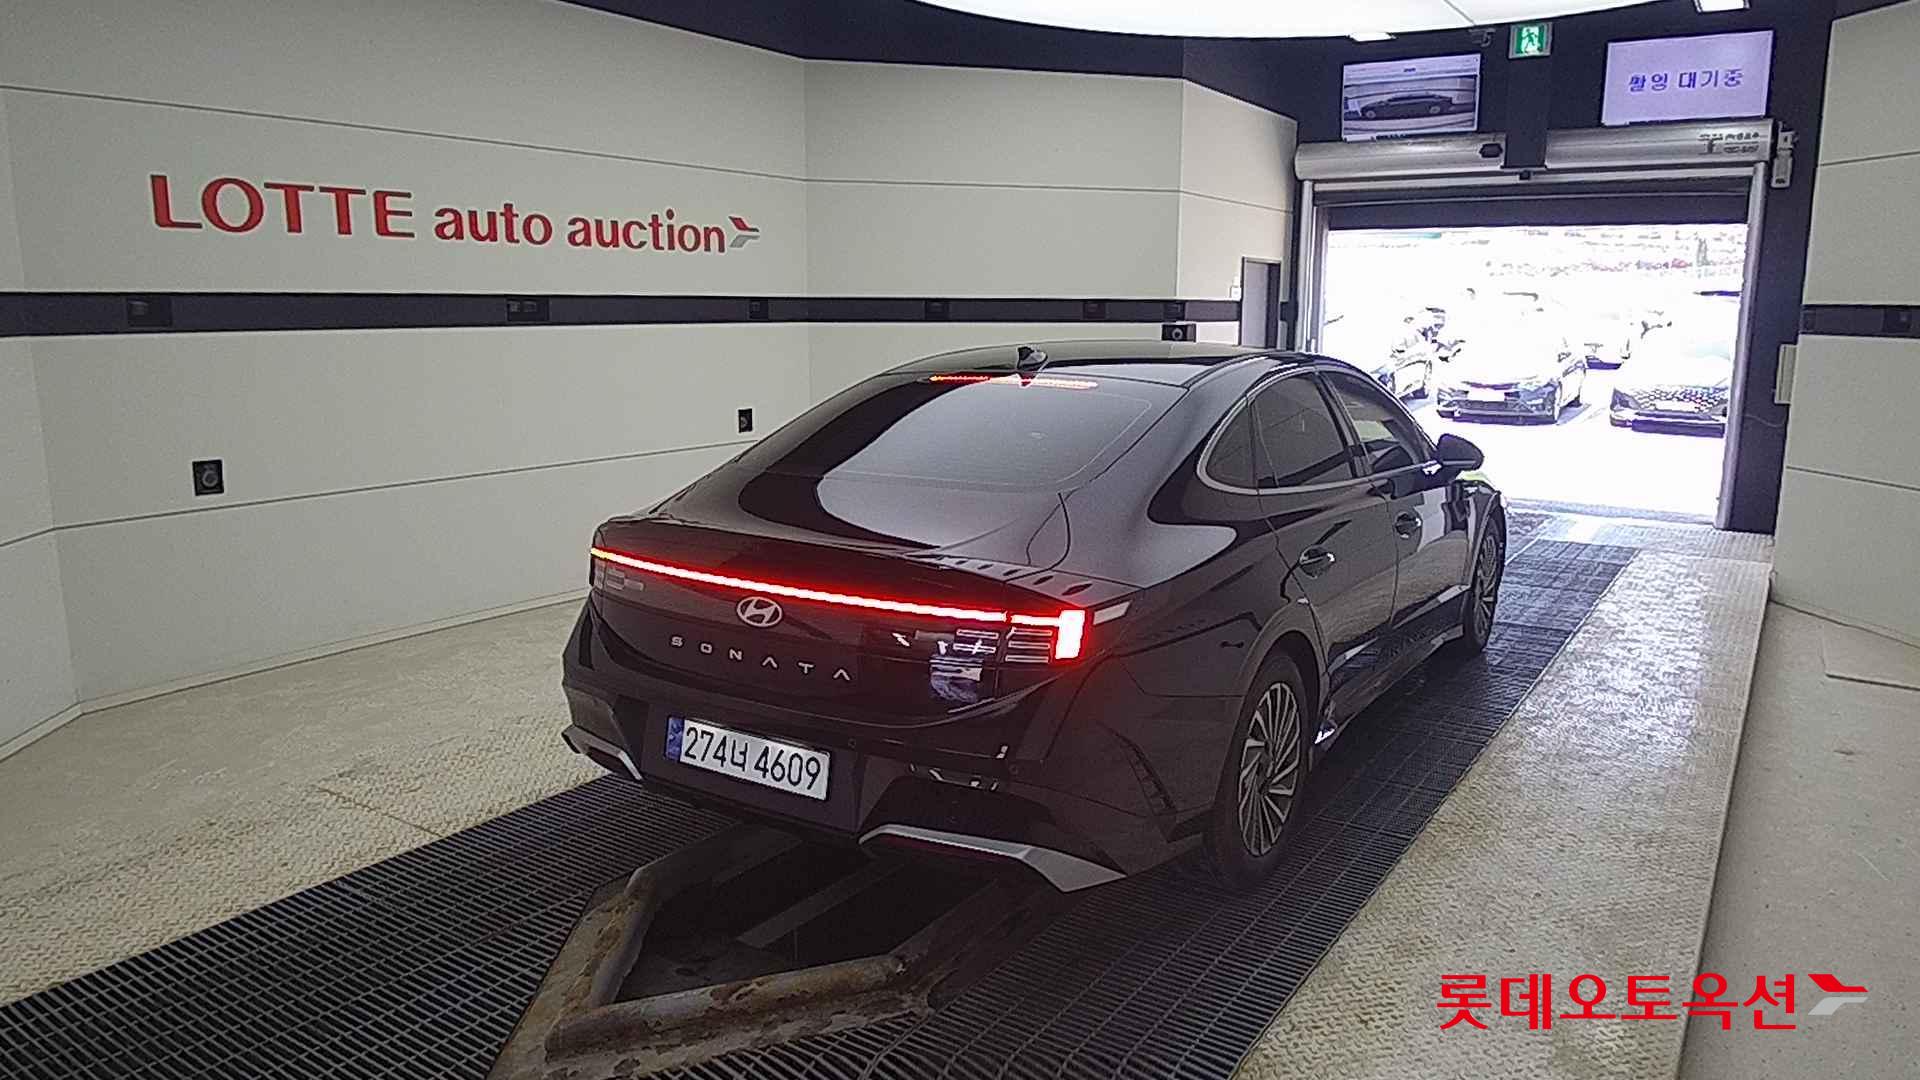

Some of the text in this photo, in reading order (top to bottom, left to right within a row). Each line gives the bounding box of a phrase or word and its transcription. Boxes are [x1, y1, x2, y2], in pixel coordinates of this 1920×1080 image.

[1677, 68, 1744, 89] 대기중
[150, 174, 725, 253] LOTTE auto auction
[671, 636, 851, 681] SONATA
[685, 727, 748, 772] 274너
[754, 746, 821, 790] 4609
